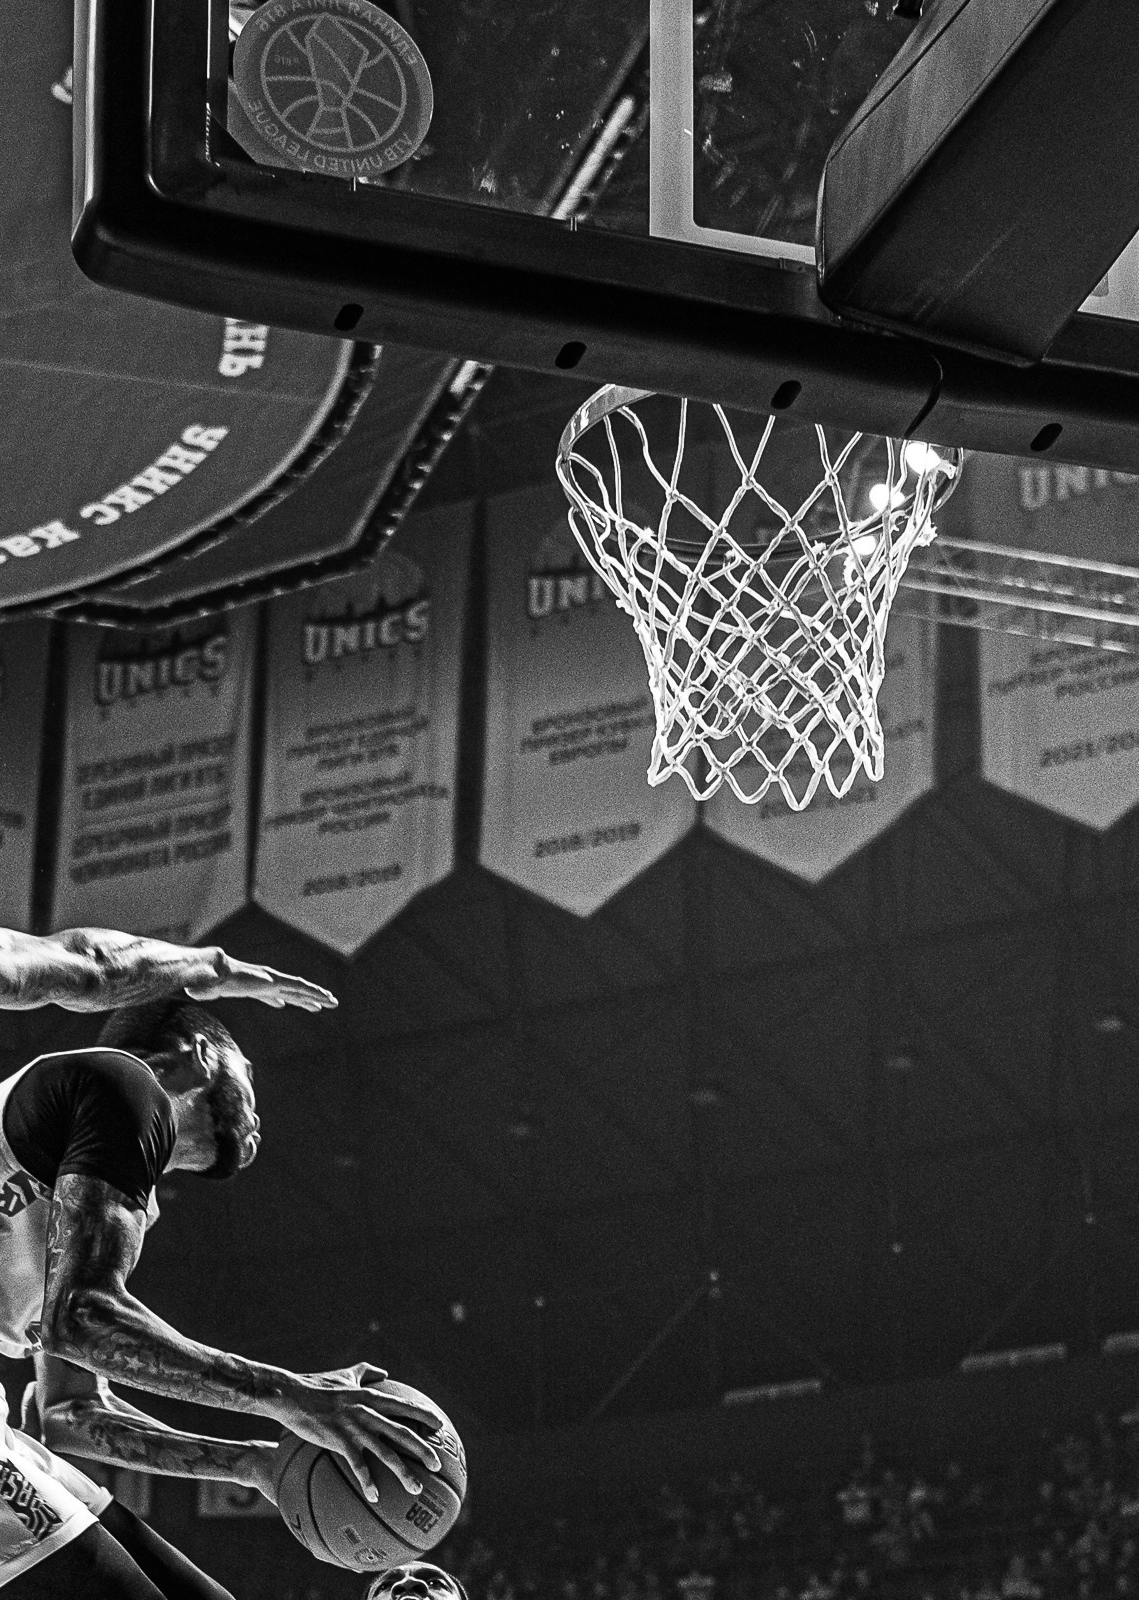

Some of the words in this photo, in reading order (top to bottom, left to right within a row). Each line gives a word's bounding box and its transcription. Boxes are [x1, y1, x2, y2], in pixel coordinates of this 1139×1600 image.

[80, 423, 230, 527] УНИКС
[303, 601, 430, 663] UNICS
[98, 636, 228, 704] UNICS
[405, 1501, 439, 1535] FIBA
